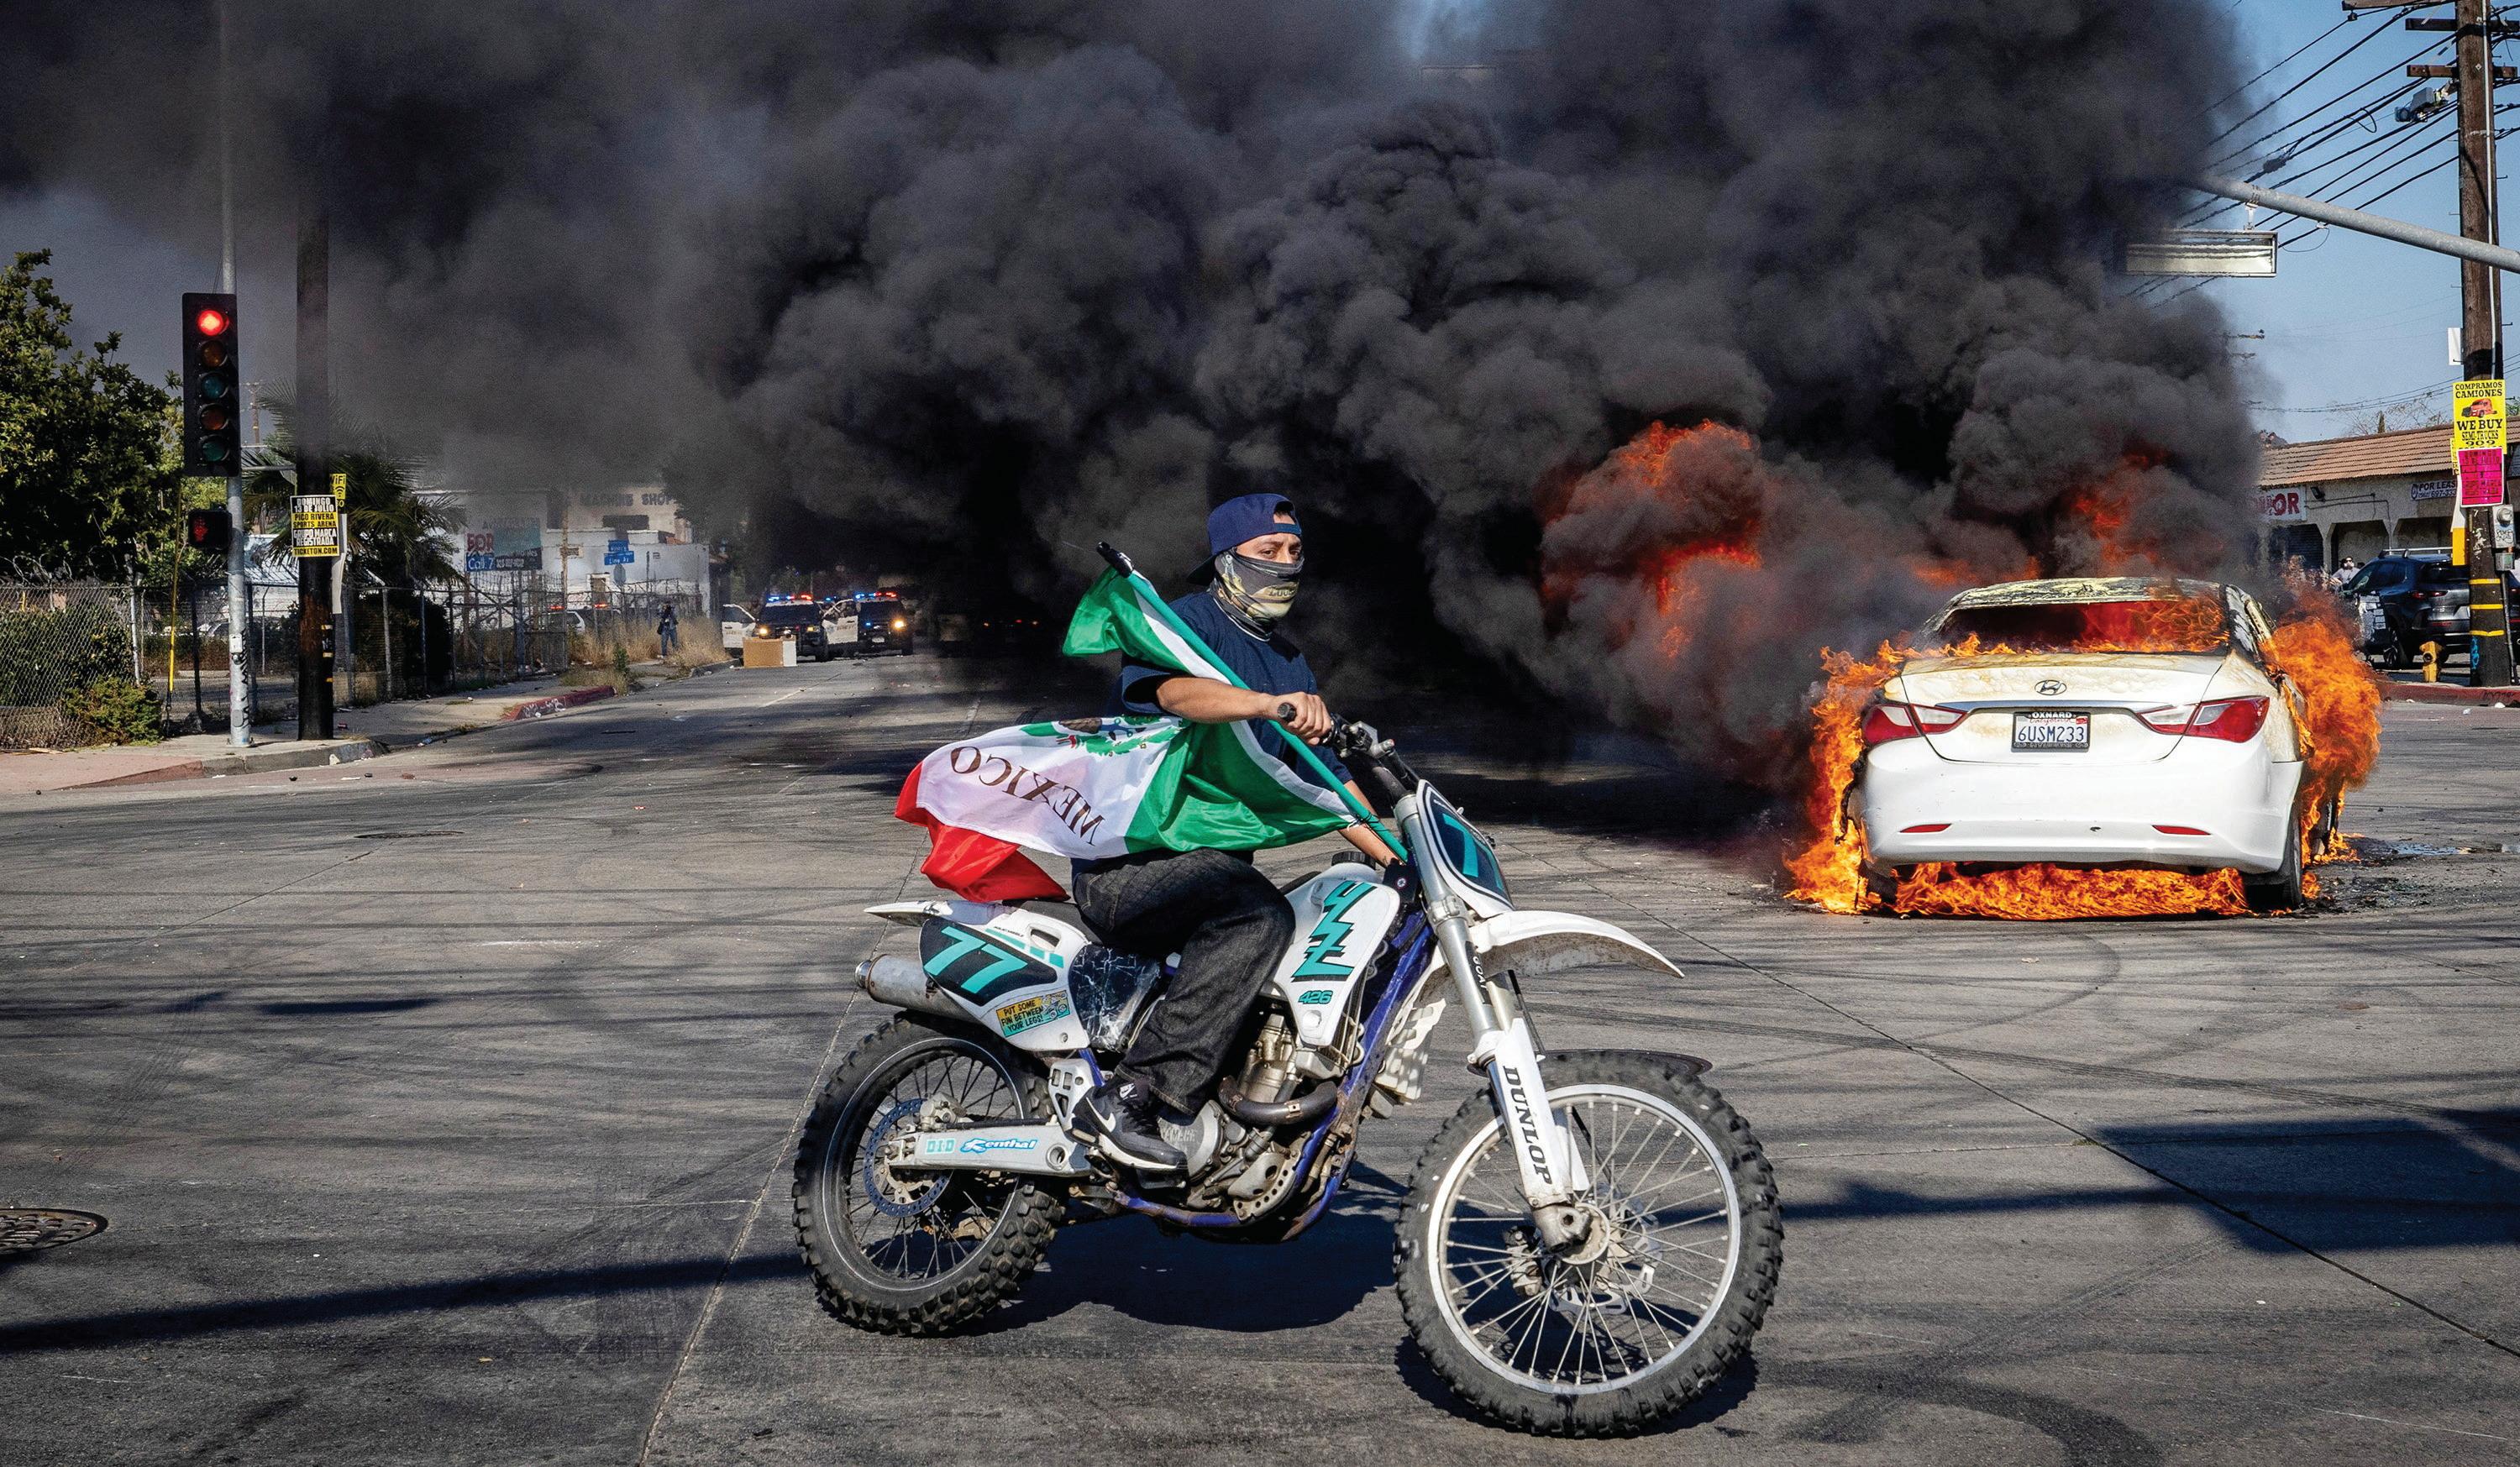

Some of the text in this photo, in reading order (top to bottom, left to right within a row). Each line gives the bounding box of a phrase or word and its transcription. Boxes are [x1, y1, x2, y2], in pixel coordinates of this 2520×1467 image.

[2455, 389, 2502, 398] CAMIONES
[2457, 419, 2502, 430] WE BUY
[2437, 480, 2456, 489] LEAS
[297, 497, 330, 506] DOMINGO
[314, 504, 334, 512] JULIO
[294, 528, 336, 538] GRUPO MARCA
[297, 537, 334, 546] REGISTRADA
[2018, 726, 2084, 741] 6USM233
[924, 926, 1028, 993] 77
[1298, 990, 1333, 1004] 426
[1004, 1000, 1036, 1016] PUT SOME
[1000, 1006, 1043, 1026] FUN BETWEEN
[1008, 1014, 1043, 1032] YOUR LEGS!
[1503, 1066, 1552, 1185] DUNLOP
[960, 1138, 1037, 1154] Renthal
